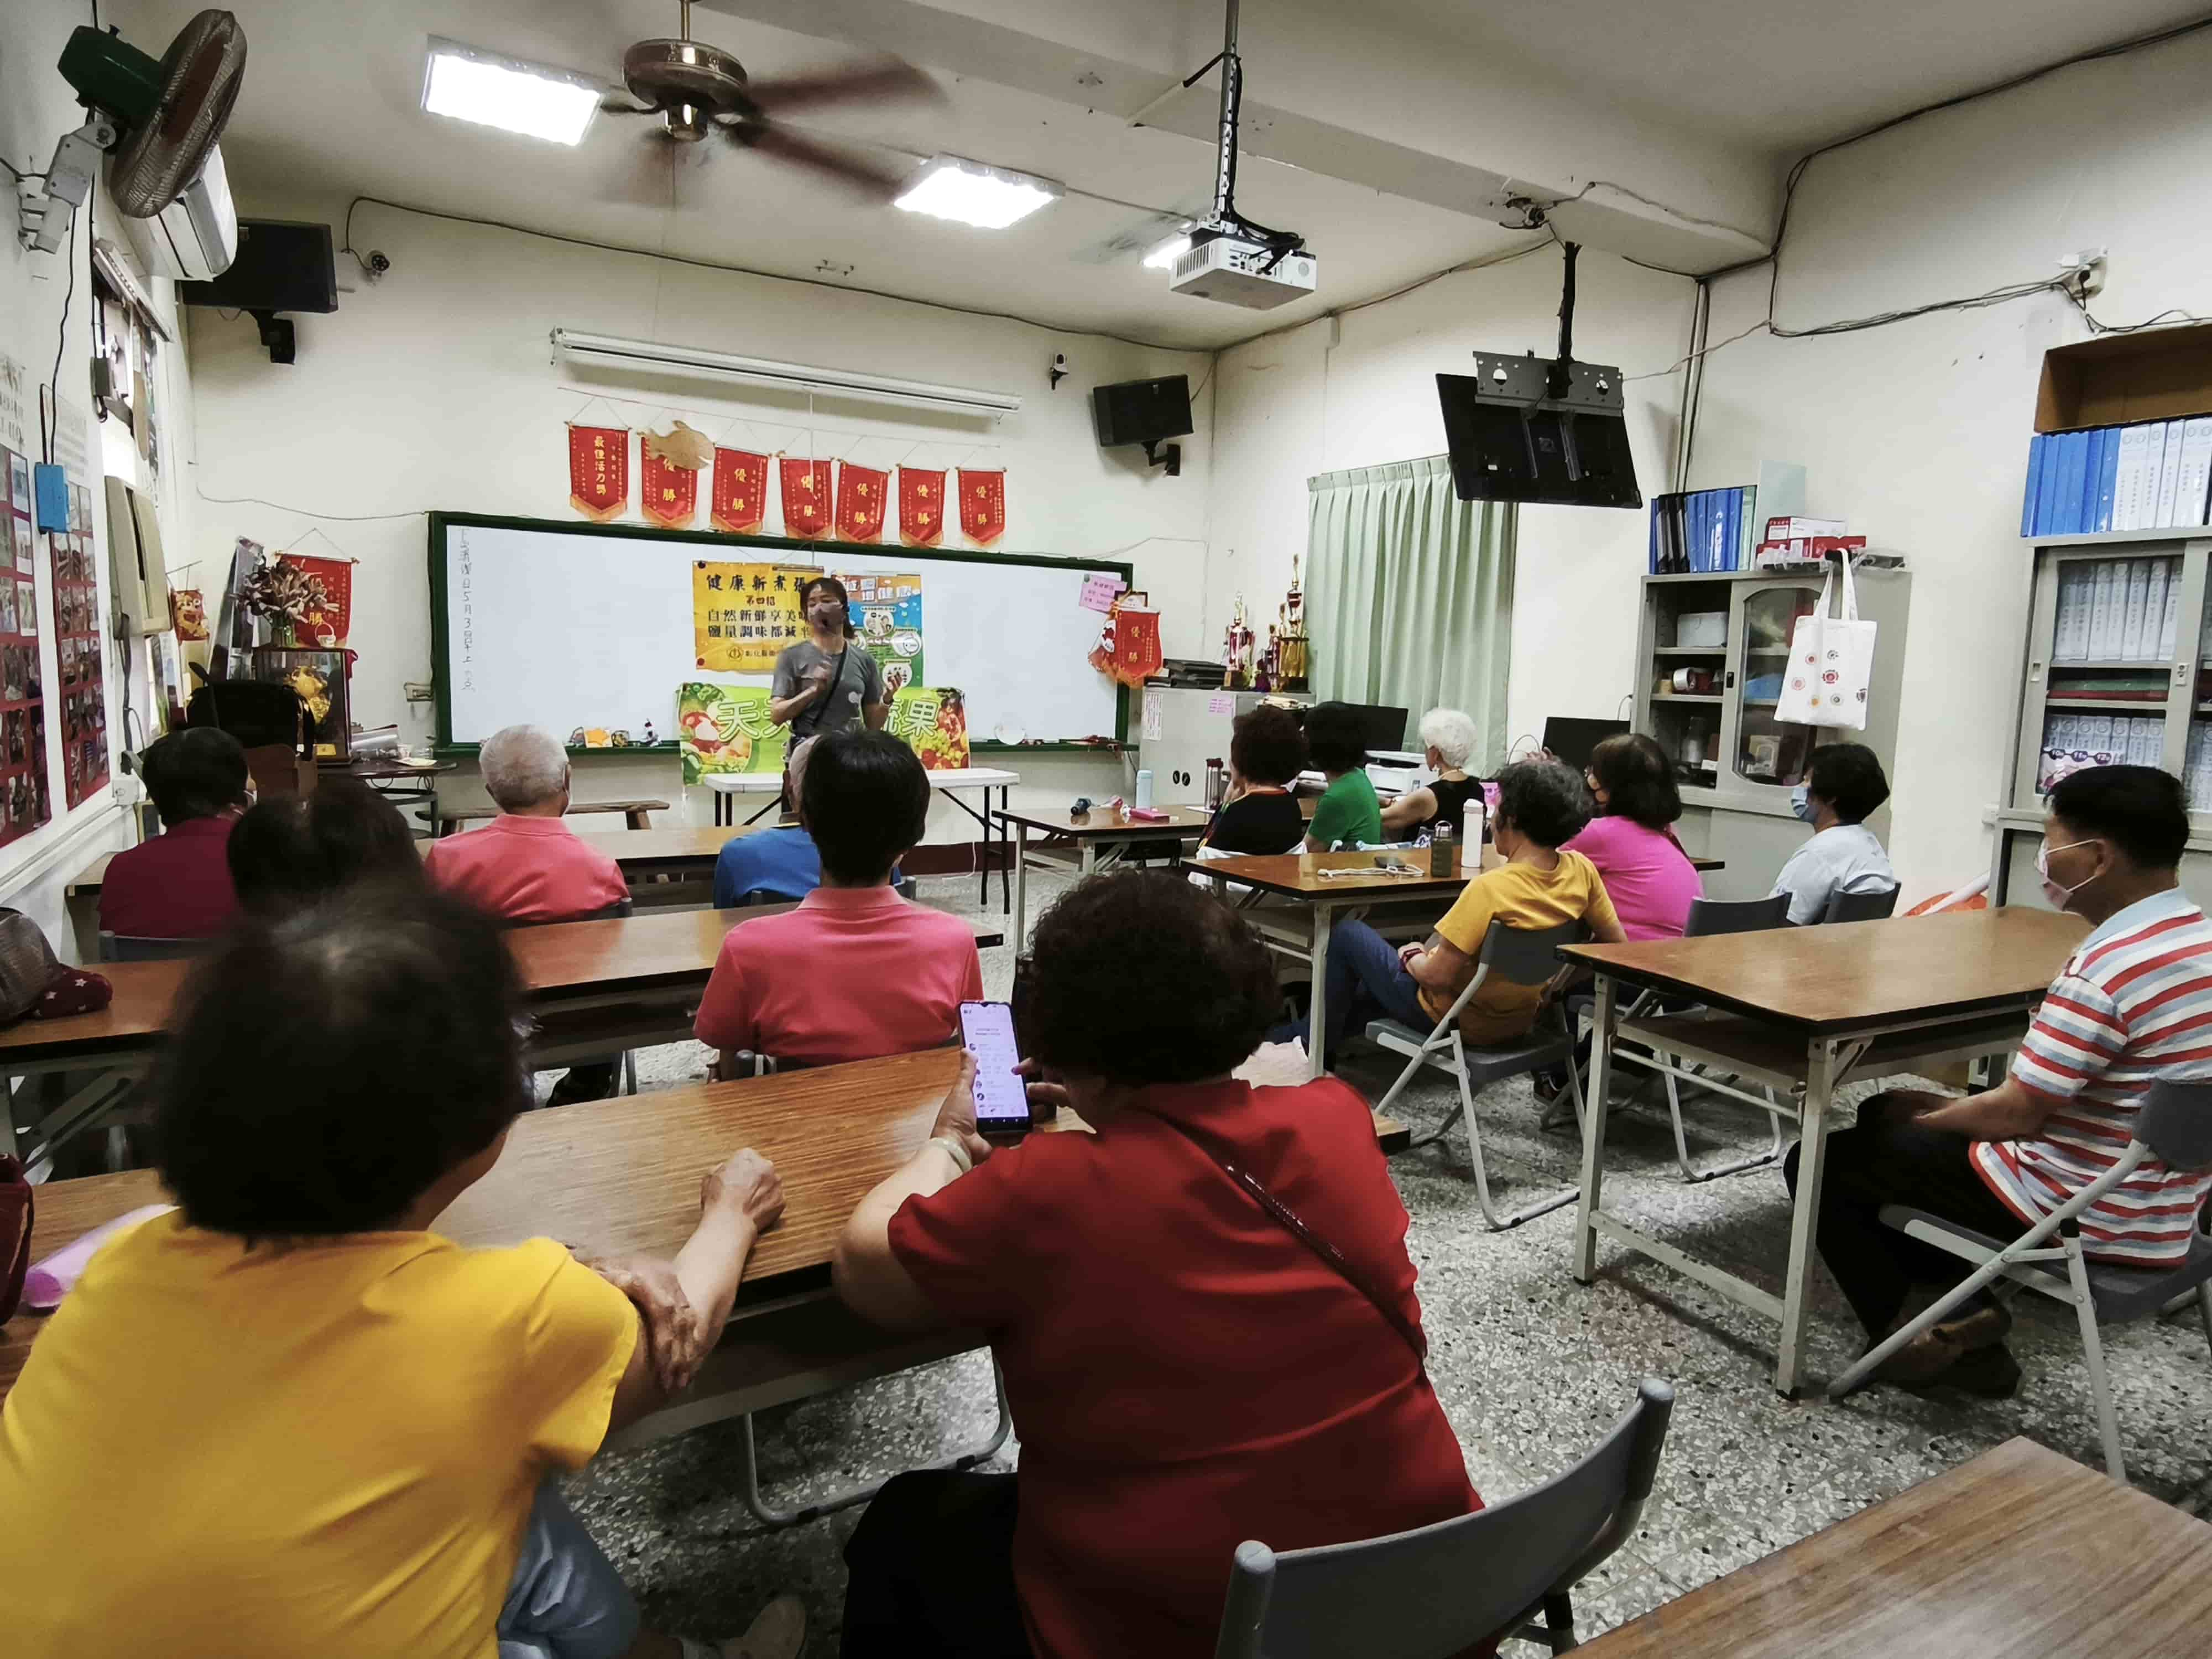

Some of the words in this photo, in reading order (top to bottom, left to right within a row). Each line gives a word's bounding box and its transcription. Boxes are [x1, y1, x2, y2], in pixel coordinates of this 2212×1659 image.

[732, 468, 747, 512] 優勝
[801, 475, 816, 517] 優勝
[854, 483, 869, 525] 優勝
[917, 484, 930, 525] 優勝
[976, 486, 987, 525] 優勝
